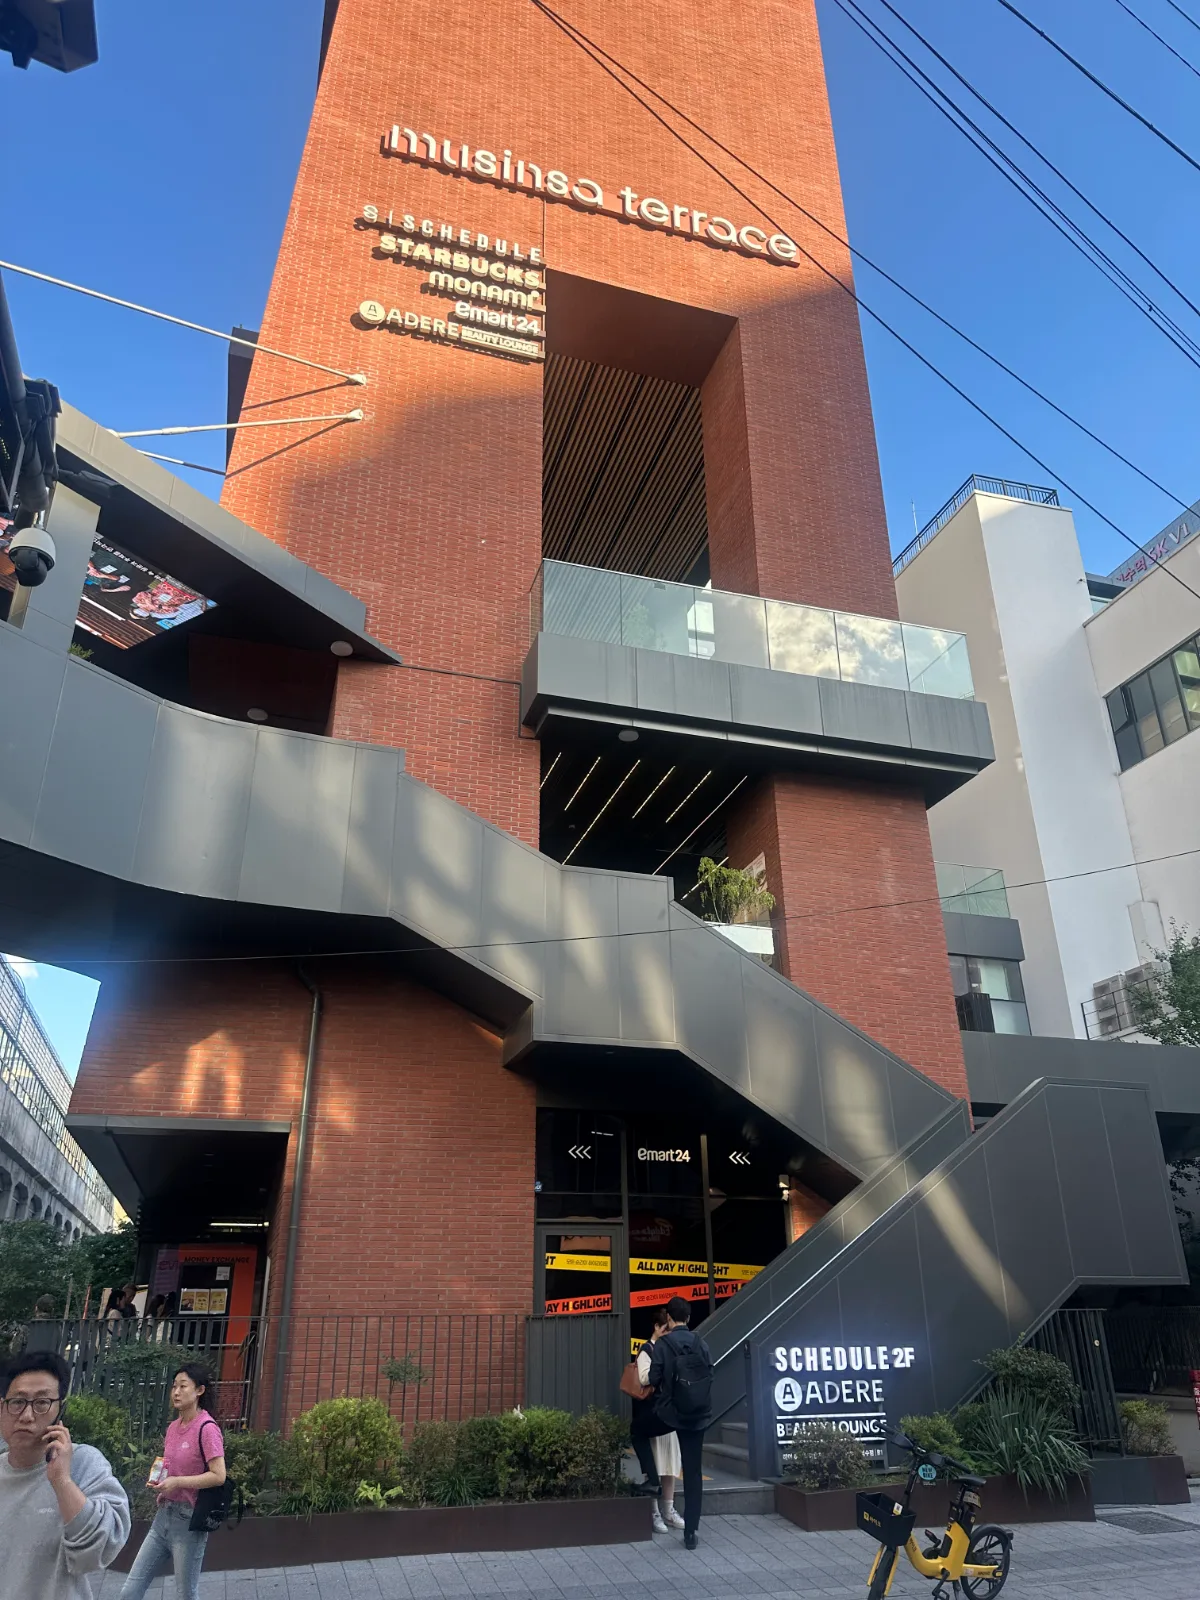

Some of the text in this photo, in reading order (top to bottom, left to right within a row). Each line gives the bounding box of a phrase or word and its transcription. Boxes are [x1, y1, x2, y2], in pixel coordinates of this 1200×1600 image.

[390, 124, 797, 261] musinsa terrace
[403, 214, 541, 265] SCHEDULE
[380, 235, 540, 289] STARBUCKS
[386, 308, 460, 340] ADERE
[455, 301, 541, 335] emart24
[1147, 538, 1169, 566] SK
[637, 1147, 691, 1163] emart24
[637, 1261, 655, 1271] ALL
[656, 1262, 676, 1272] DAY
[691, 1288, 709, 1297] ALL
[545, 1303, 559, 1313] AY
[774, 1346, 915, 1372] SCHEDULE 2F
[805, 1380, 885, 1405] ADERE
